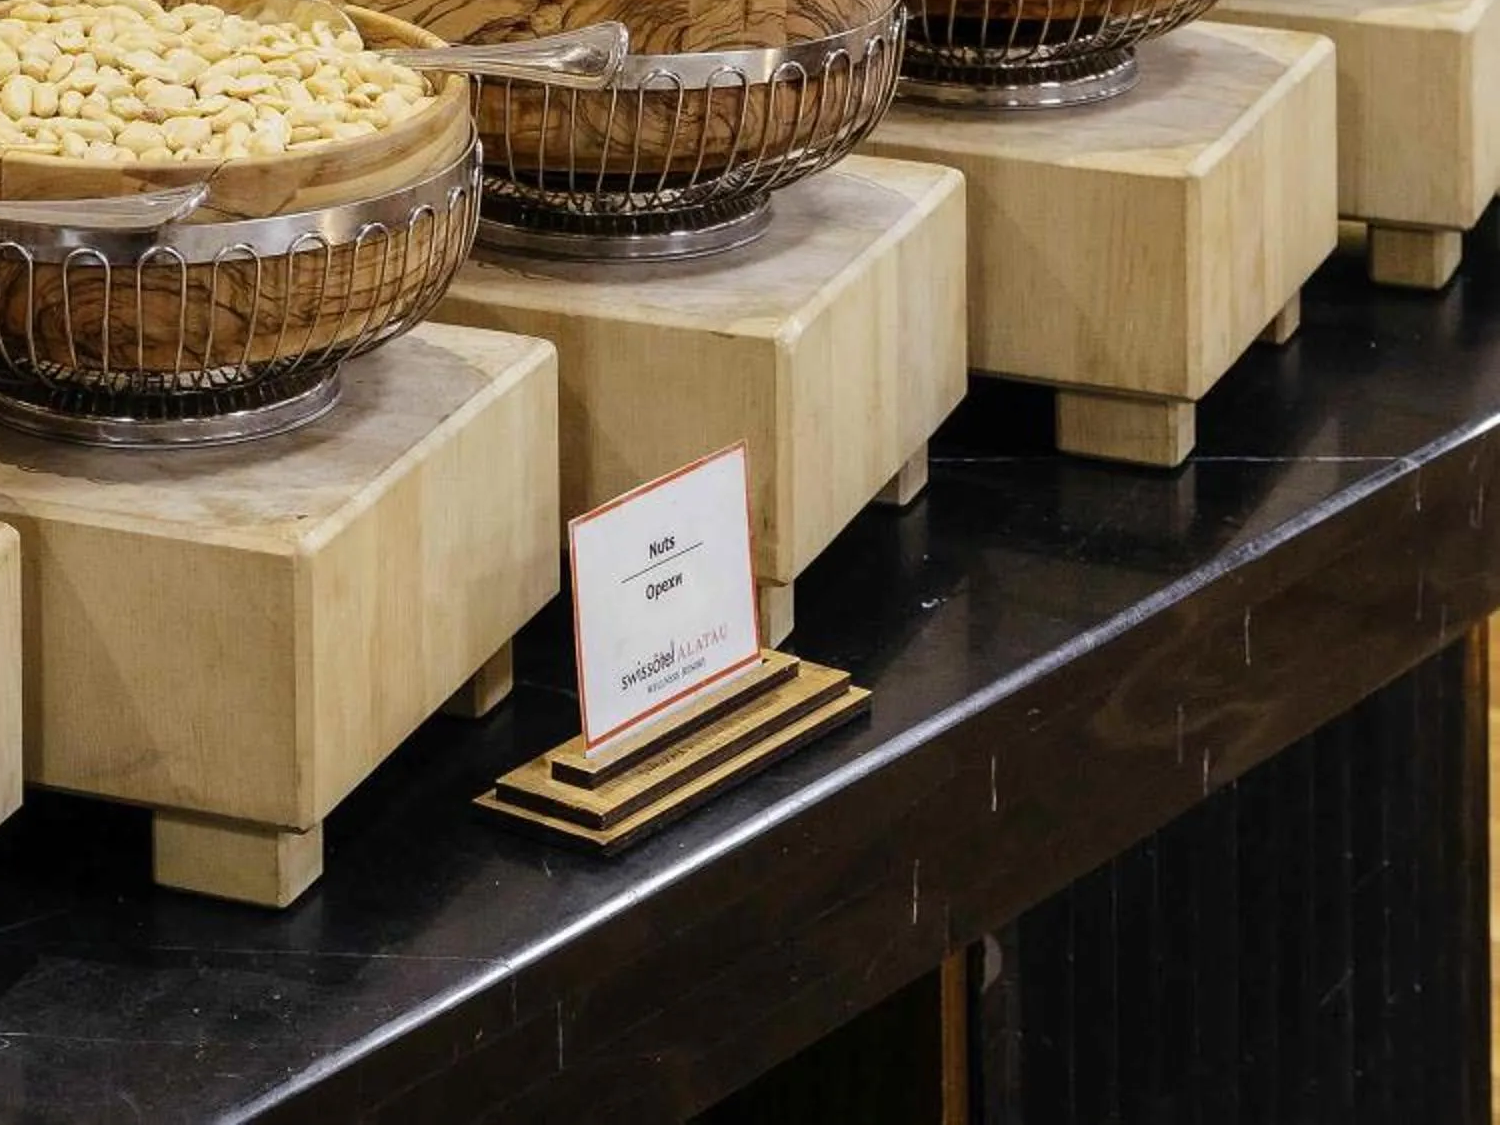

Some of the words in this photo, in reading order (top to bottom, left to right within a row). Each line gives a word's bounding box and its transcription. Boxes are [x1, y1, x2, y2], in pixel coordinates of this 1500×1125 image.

[648, 535, 676, 560] Nuts
[645, 572, 684, 601] Орехи
[677, 622, 728, 663] ALATAU
